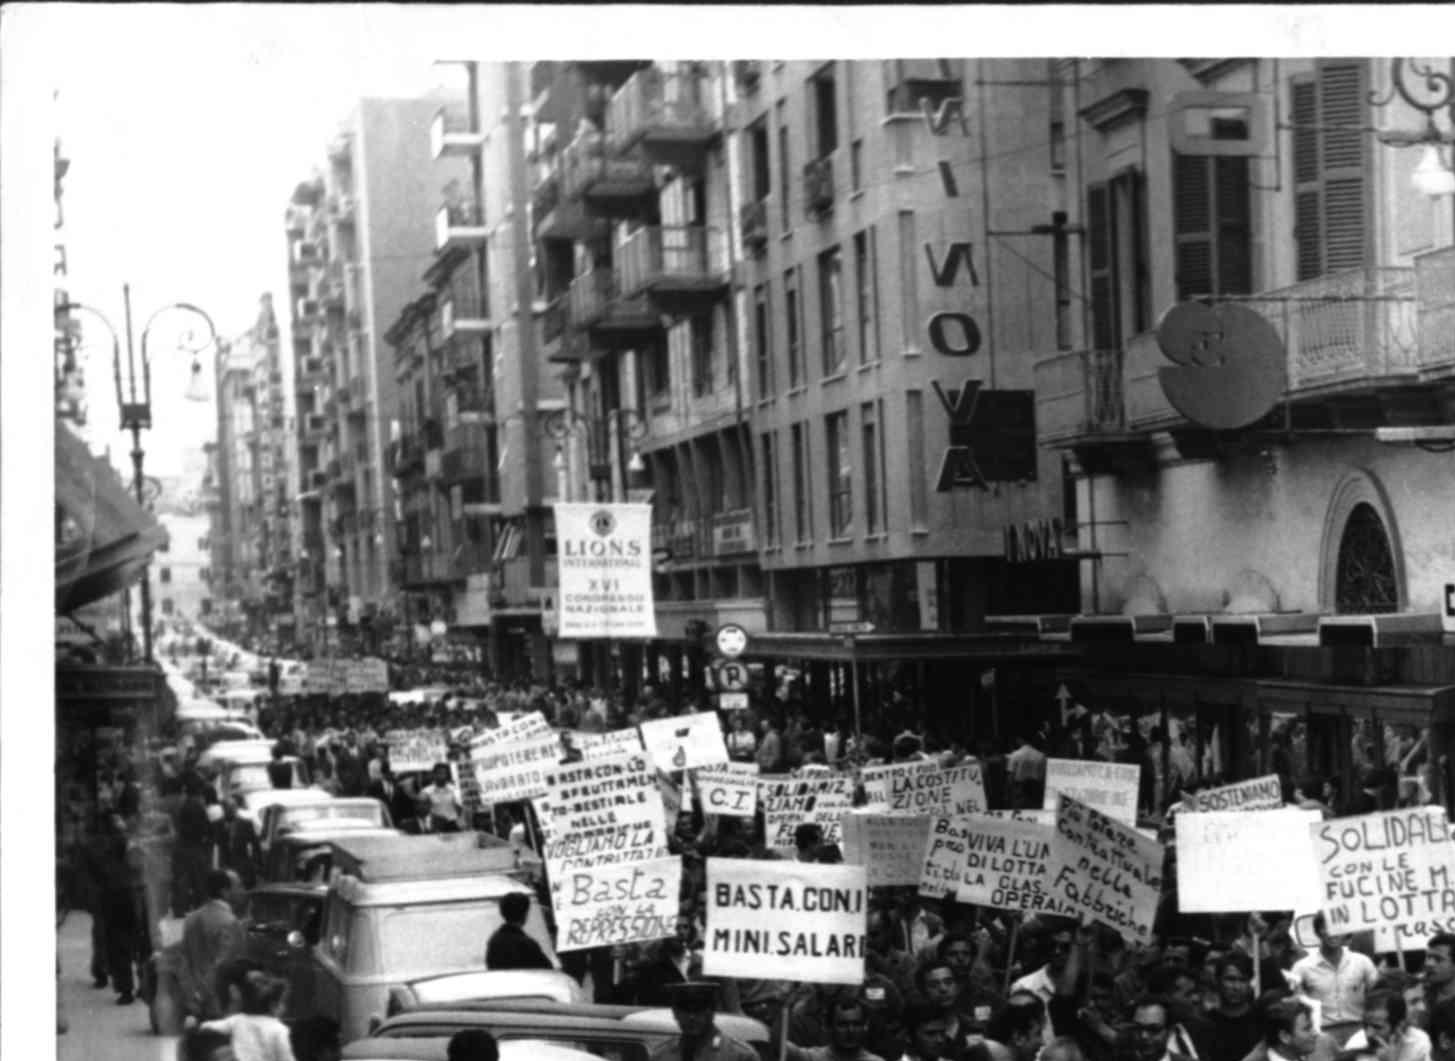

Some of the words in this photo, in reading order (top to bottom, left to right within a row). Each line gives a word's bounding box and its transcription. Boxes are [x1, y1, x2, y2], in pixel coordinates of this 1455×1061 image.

[564, 540, 641, 556] LIONS
[893, 779, 913, 793] LA
[892, 787, 952, 809] ZIONE
[968, 832, 1005, 854] VIVA
[967, 853, 987, 869] DI
[991, 857, 1046, 876] LOTTA
[1329, 860, 1373, 879] CON
[1383, 852, 1410, 871] LE
[571, 868, 667, 906] Basta
[964, 872, 985, 885] LA
[1326, 868, 1418, 901] FUCINE
[1330, 903, 1349, 925] IN
